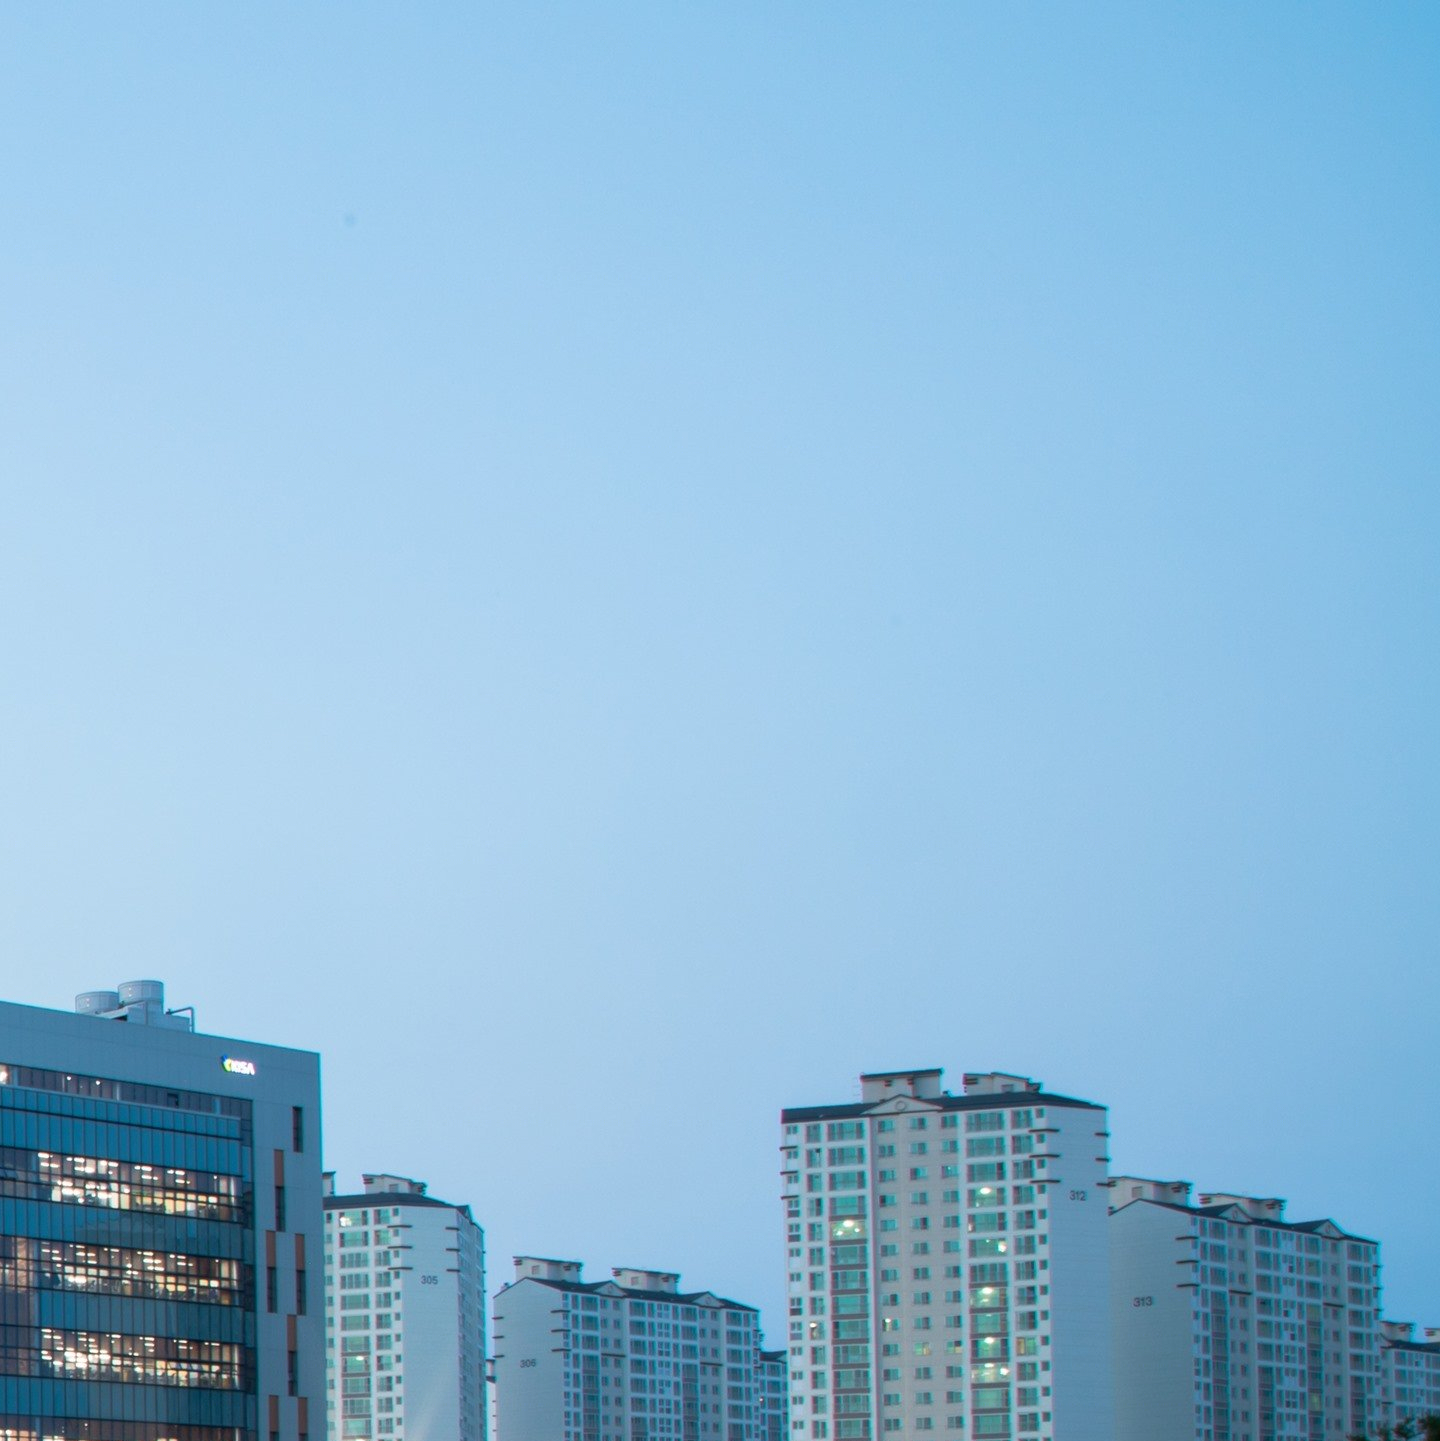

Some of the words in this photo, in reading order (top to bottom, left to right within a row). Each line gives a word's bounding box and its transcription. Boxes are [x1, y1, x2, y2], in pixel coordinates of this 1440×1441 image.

[230, 1060, 257, 1076] KISA
[1069, 1190, 1088, 1201] 312
[421, 1275, 439, 1285] 305
[1133, 1296, 1154, 1307] 313
